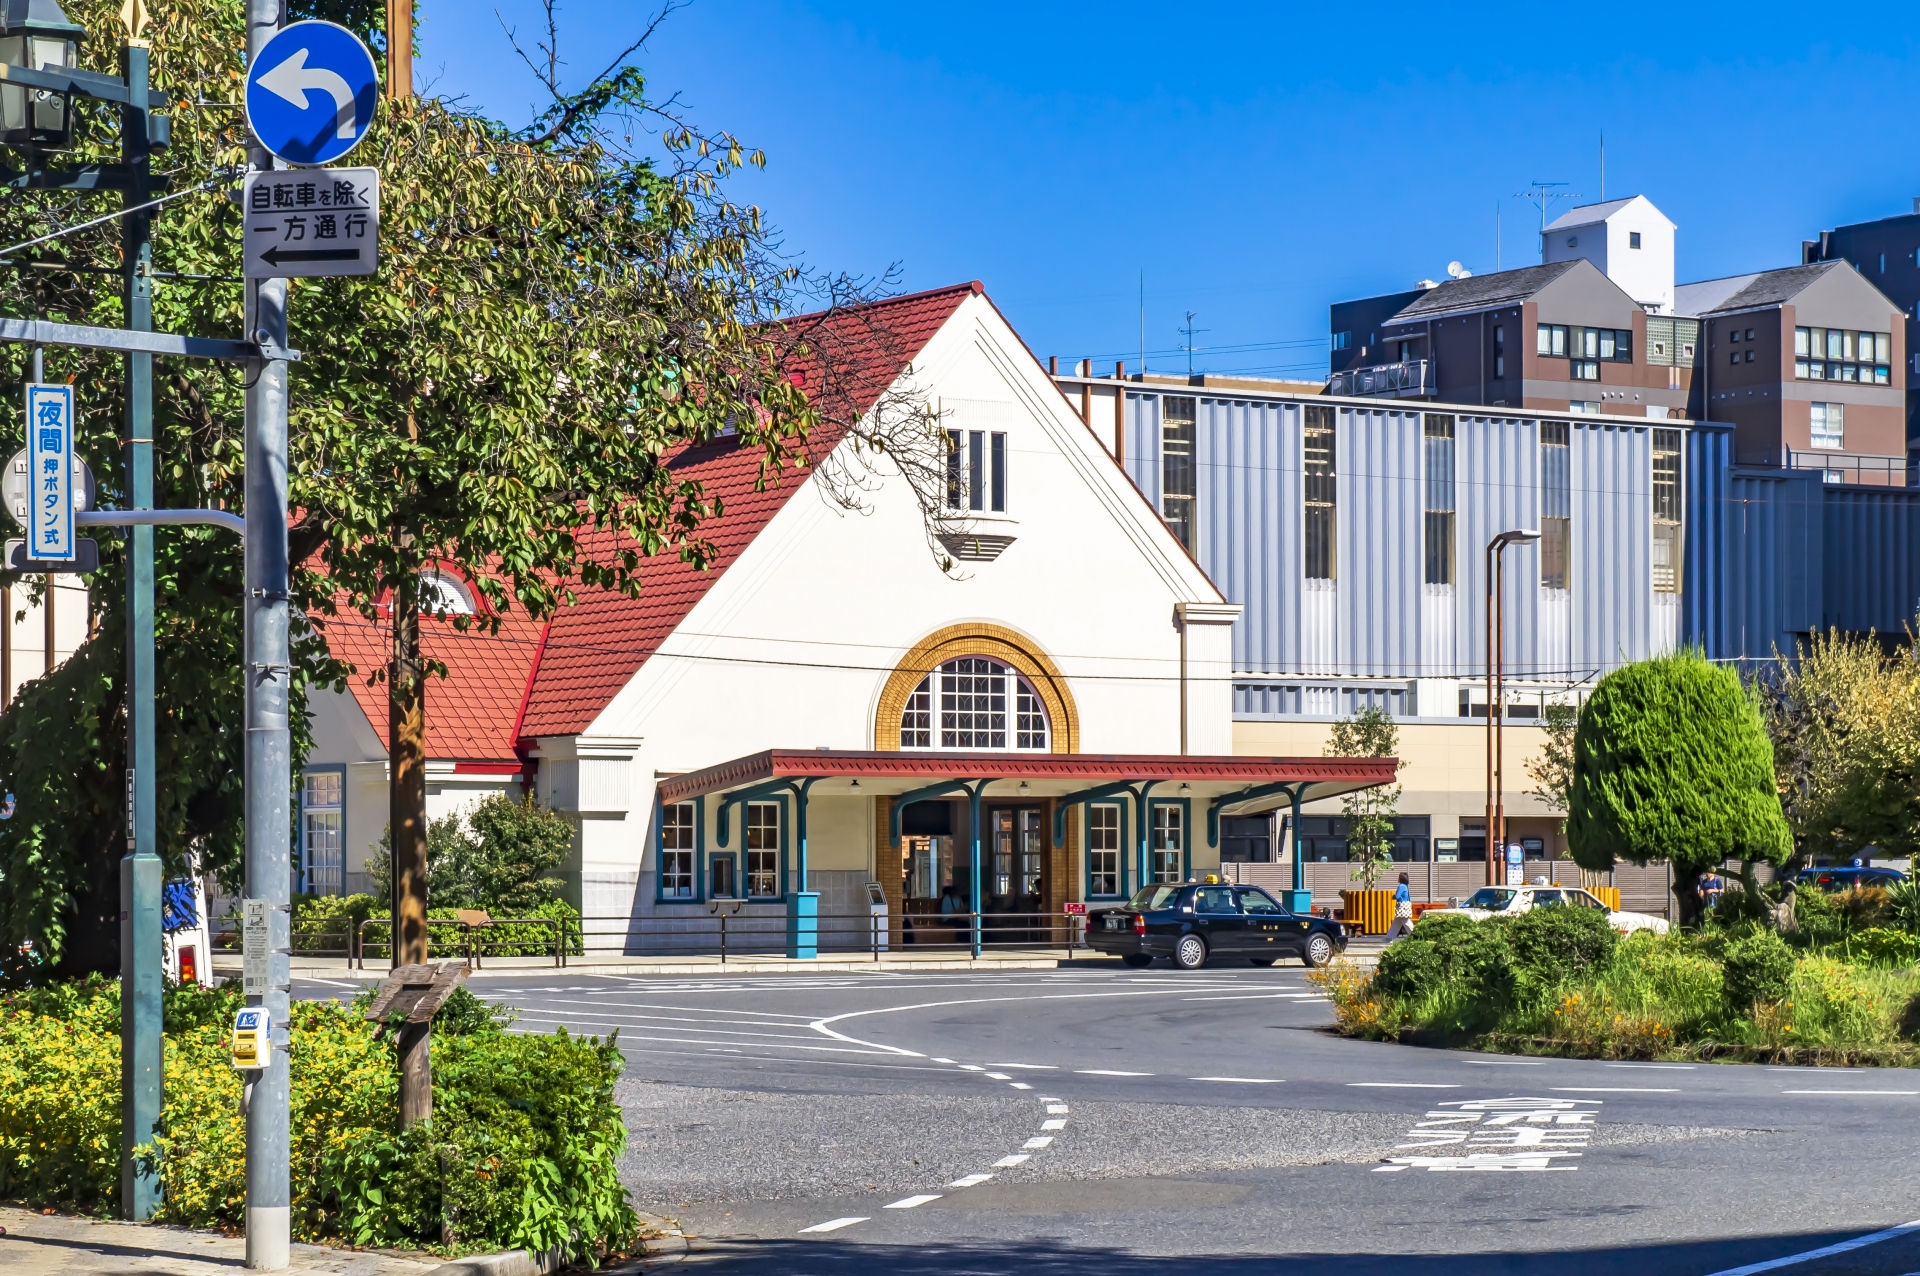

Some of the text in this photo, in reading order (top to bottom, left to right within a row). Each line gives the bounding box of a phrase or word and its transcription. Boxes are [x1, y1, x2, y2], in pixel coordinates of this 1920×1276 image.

[251, 180, 369, 209] 自転車を除く
[253, 213, 368, 241] 一方通行
[38, 399, 63, 545] 夜間押ボタン式
[1371, 1096, 1604, 1172] 合流注意
